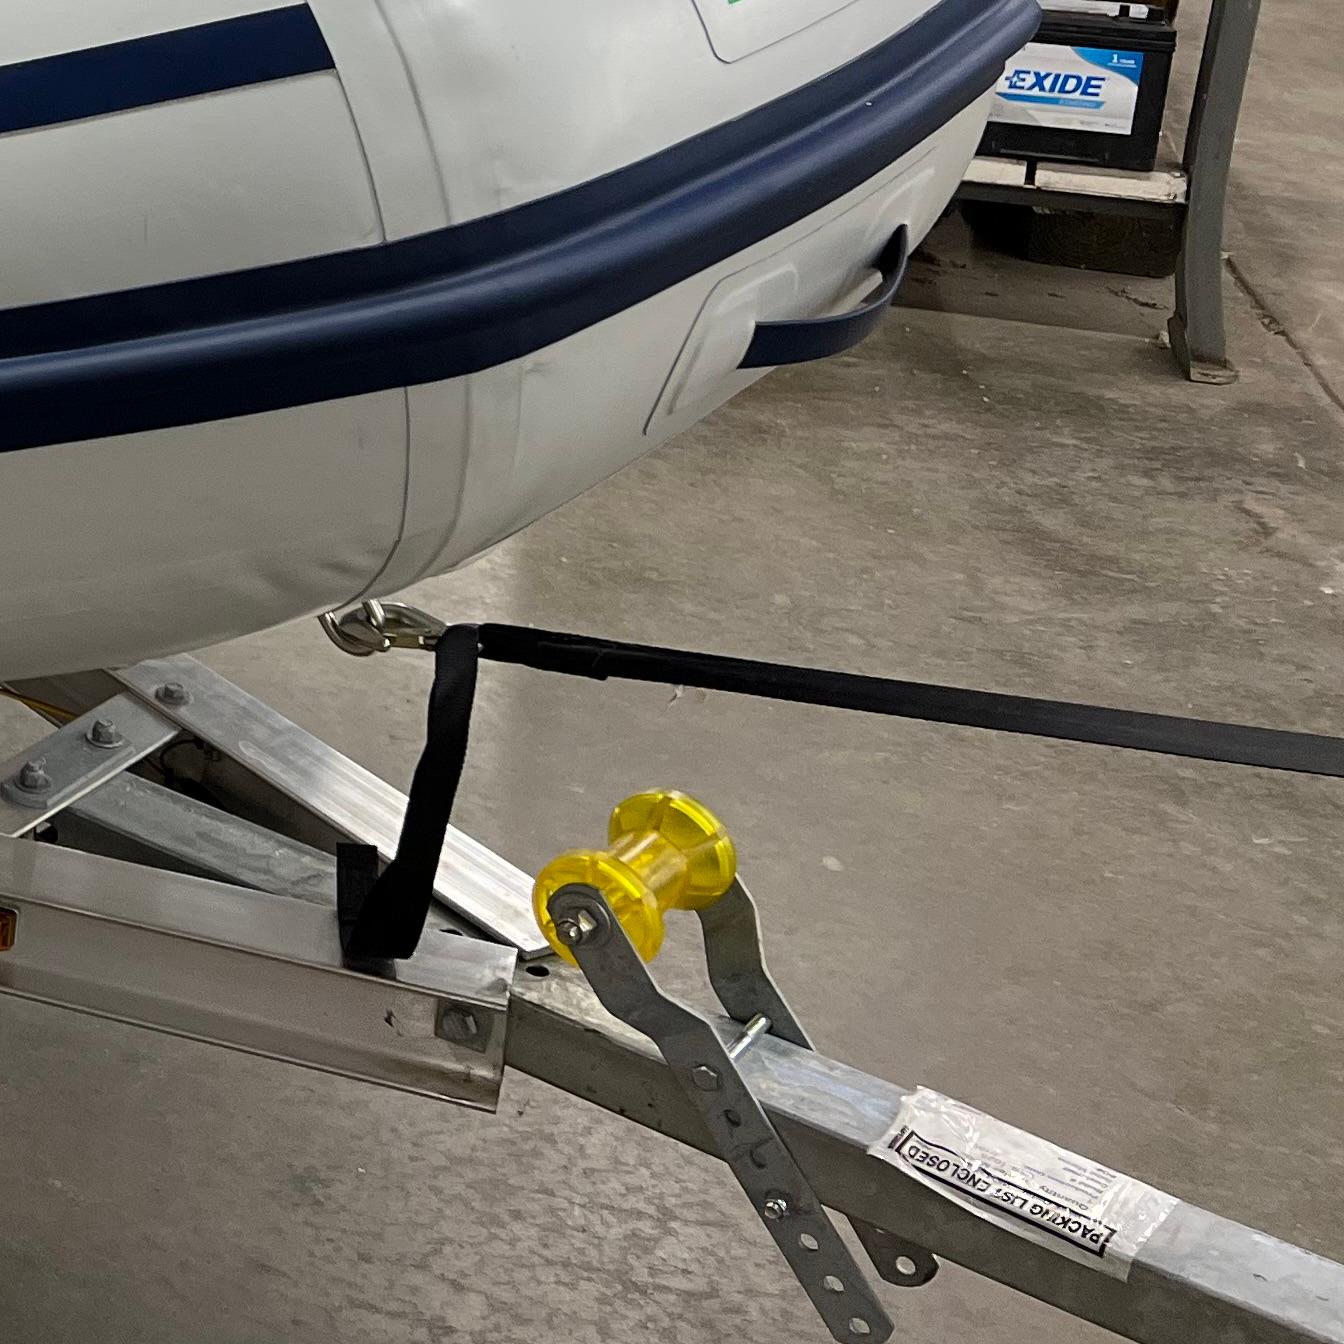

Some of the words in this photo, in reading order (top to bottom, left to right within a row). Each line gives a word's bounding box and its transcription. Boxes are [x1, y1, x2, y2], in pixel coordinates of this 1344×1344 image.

[1005, 68, 1107, 98] EXIDE
[907, 1144, 991, 1193] ENCLOSED
[992, 1187, 1029, 1210] LIST
[1029, 1202, 1105, 1246] PACKING
